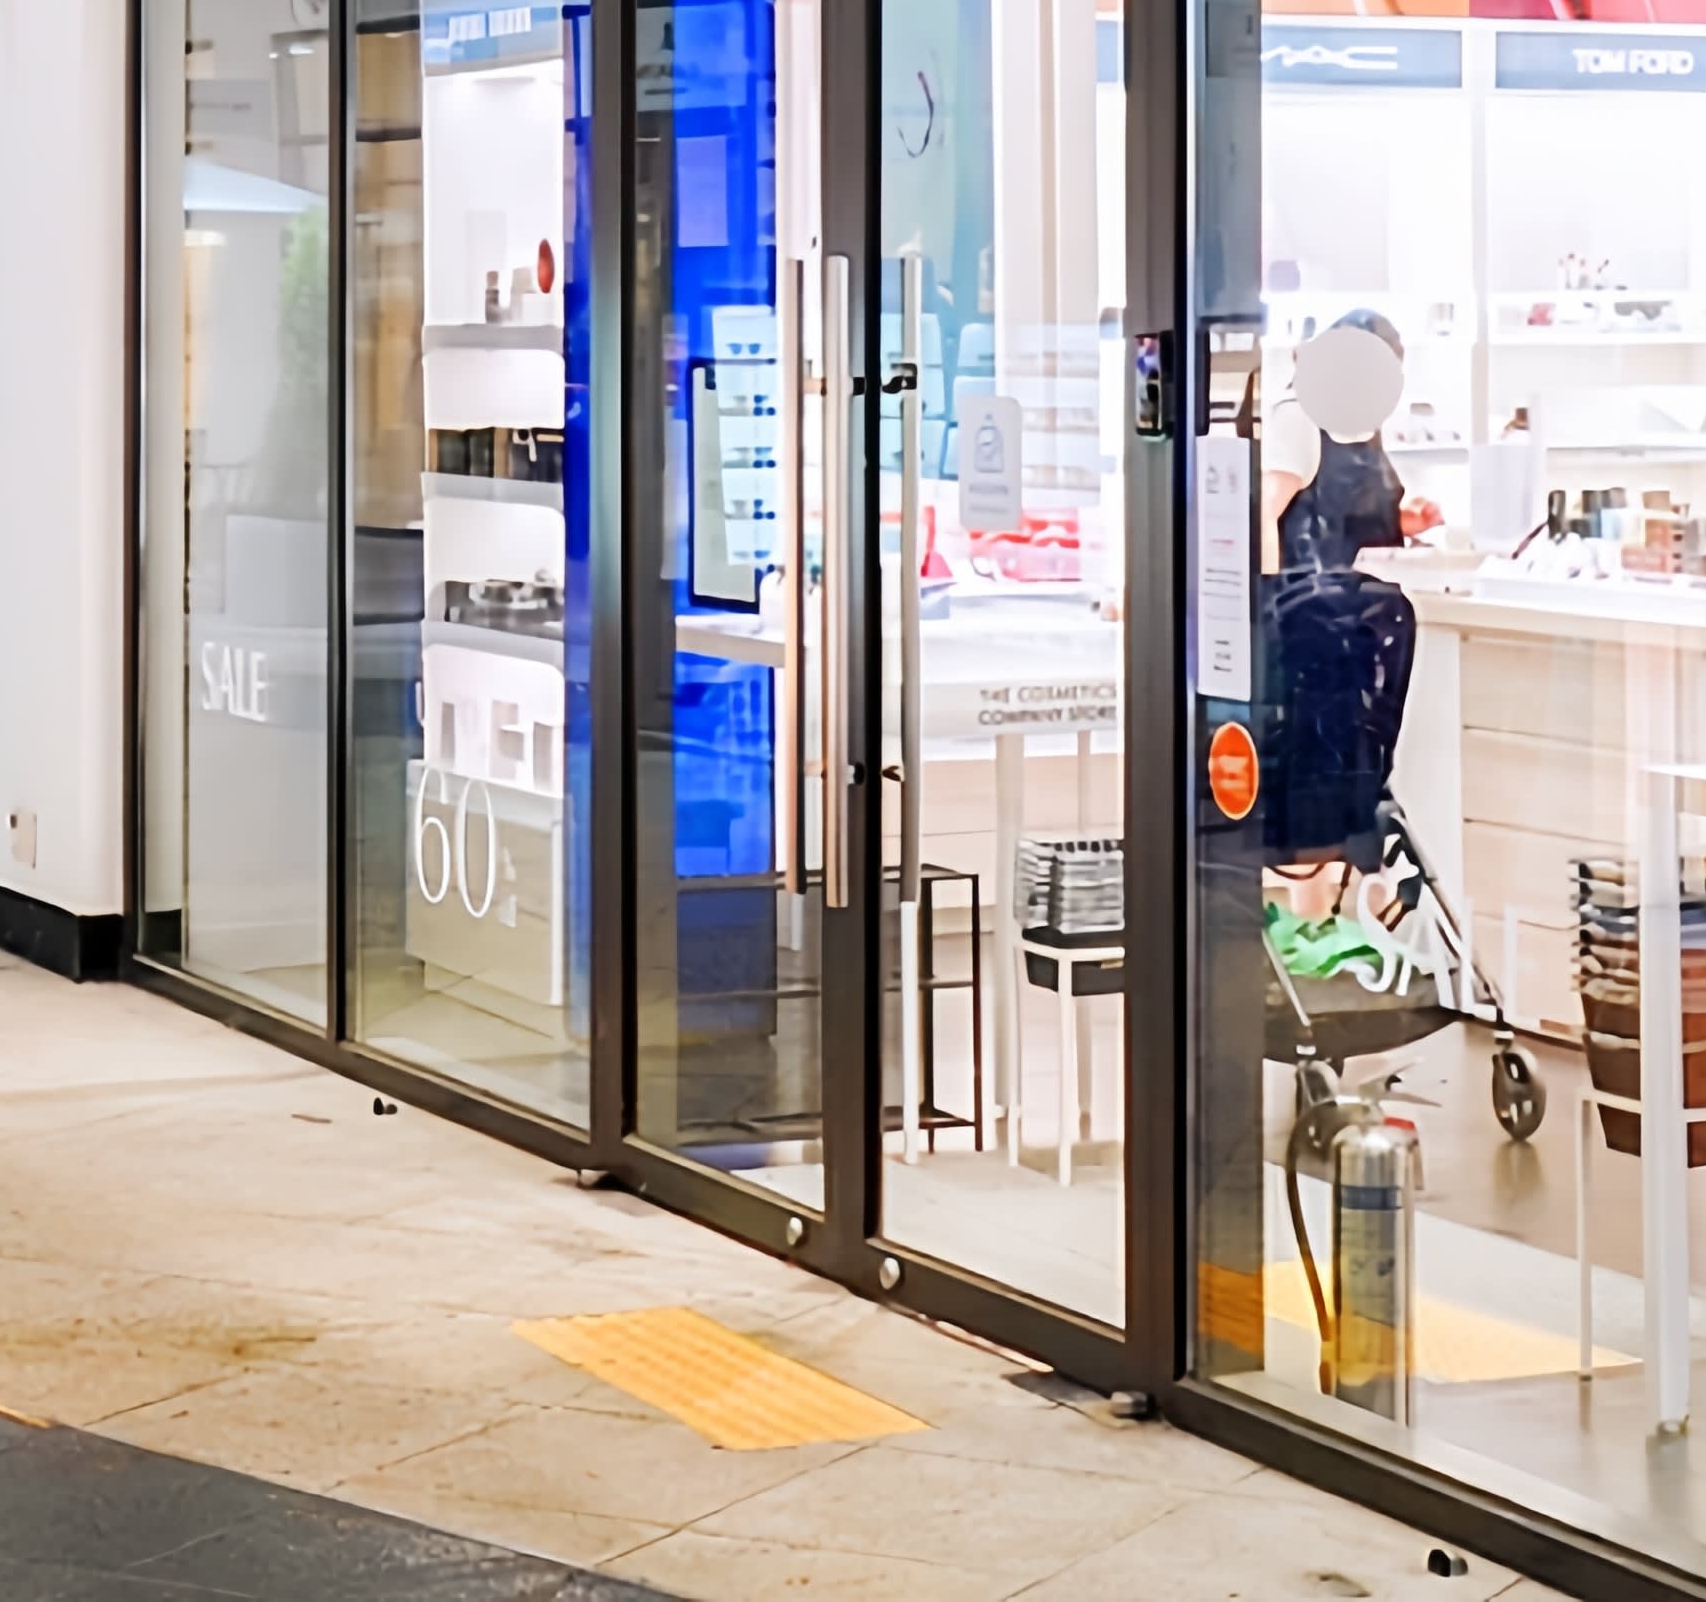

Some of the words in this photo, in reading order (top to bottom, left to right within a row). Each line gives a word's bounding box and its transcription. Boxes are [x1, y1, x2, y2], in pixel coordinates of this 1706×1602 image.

[1572, 47, 1625, 75] TOM
[1629, 48, 1695, 76] FORD
[201, 641, 271, 723] SALE
